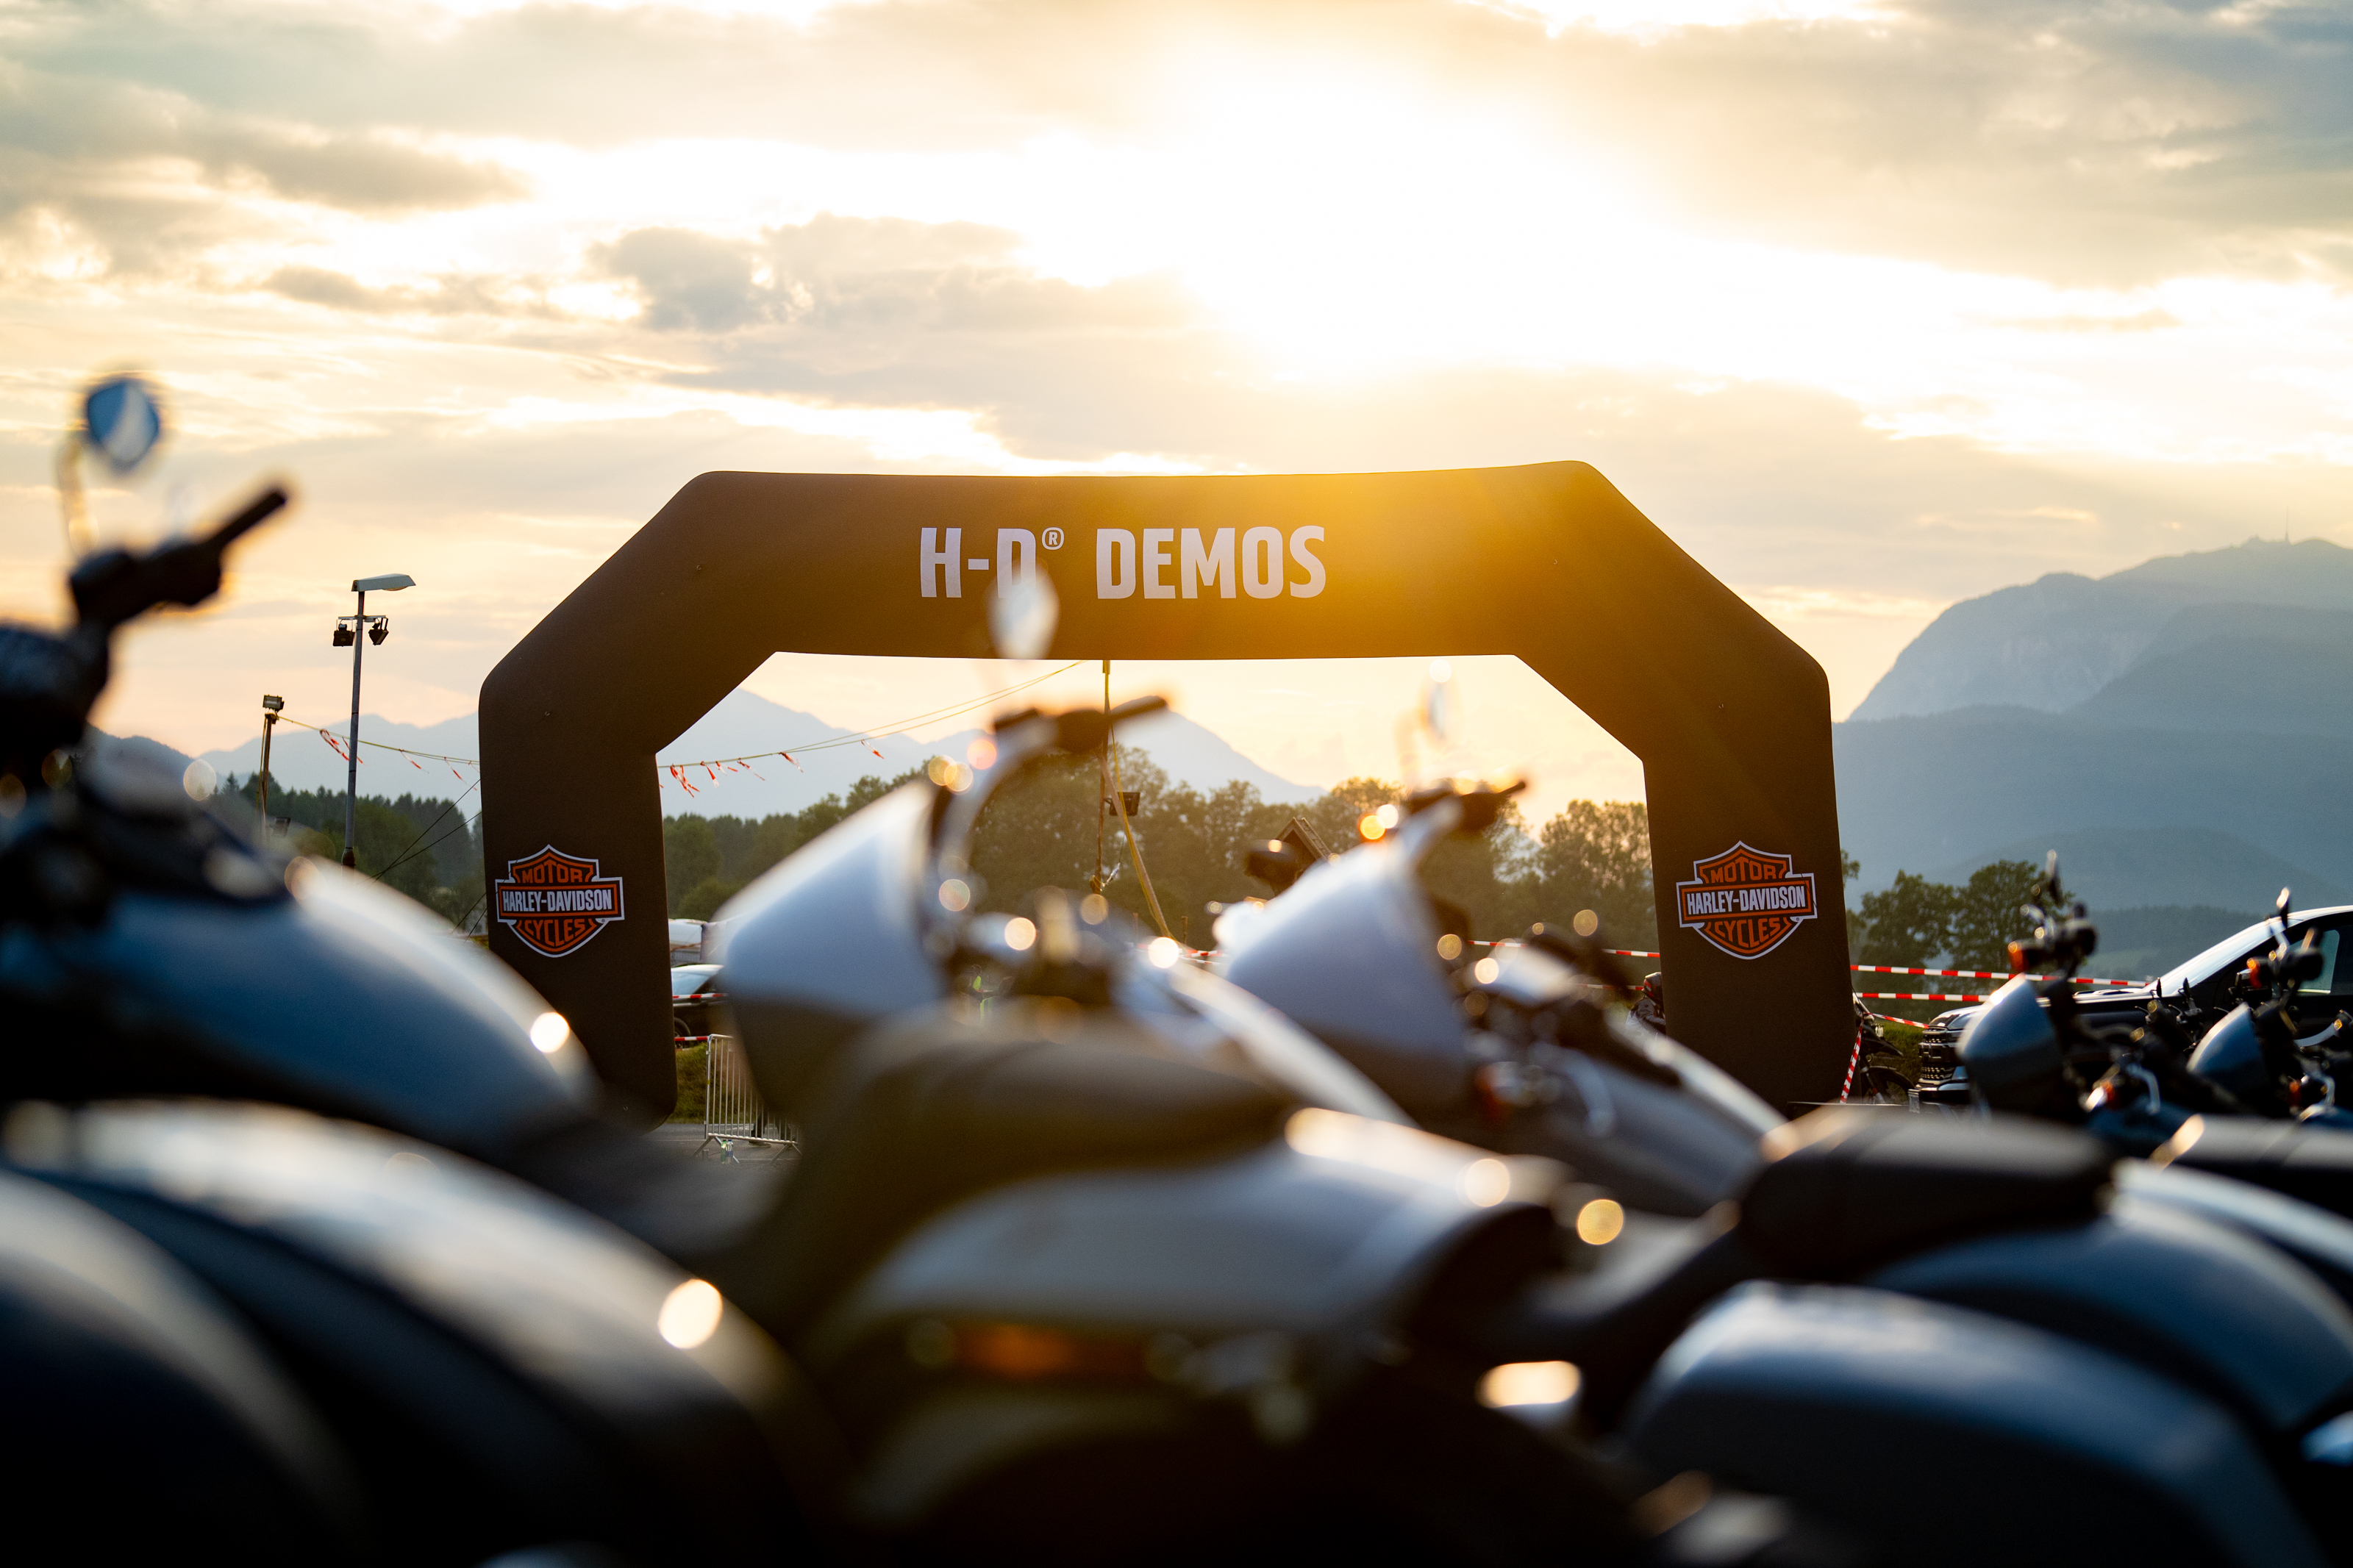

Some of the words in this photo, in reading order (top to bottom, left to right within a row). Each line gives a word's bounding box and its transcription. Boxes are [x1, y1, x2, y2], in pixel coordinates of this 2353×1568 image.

[1096, 525, 1327, 600] DEMOS
[521, 859, 583, 884] MOTOR
[1710, 856, 1777, 884] MOTOR
[502, 889, 613, 912] HARLEY-DAVIDSON
[1687, 885, 1806, 915] HARLEY-DAVIDSON
[524, 918, 586, 947] CYCLES
[1714, 917, 1781, 948] CYCLES
